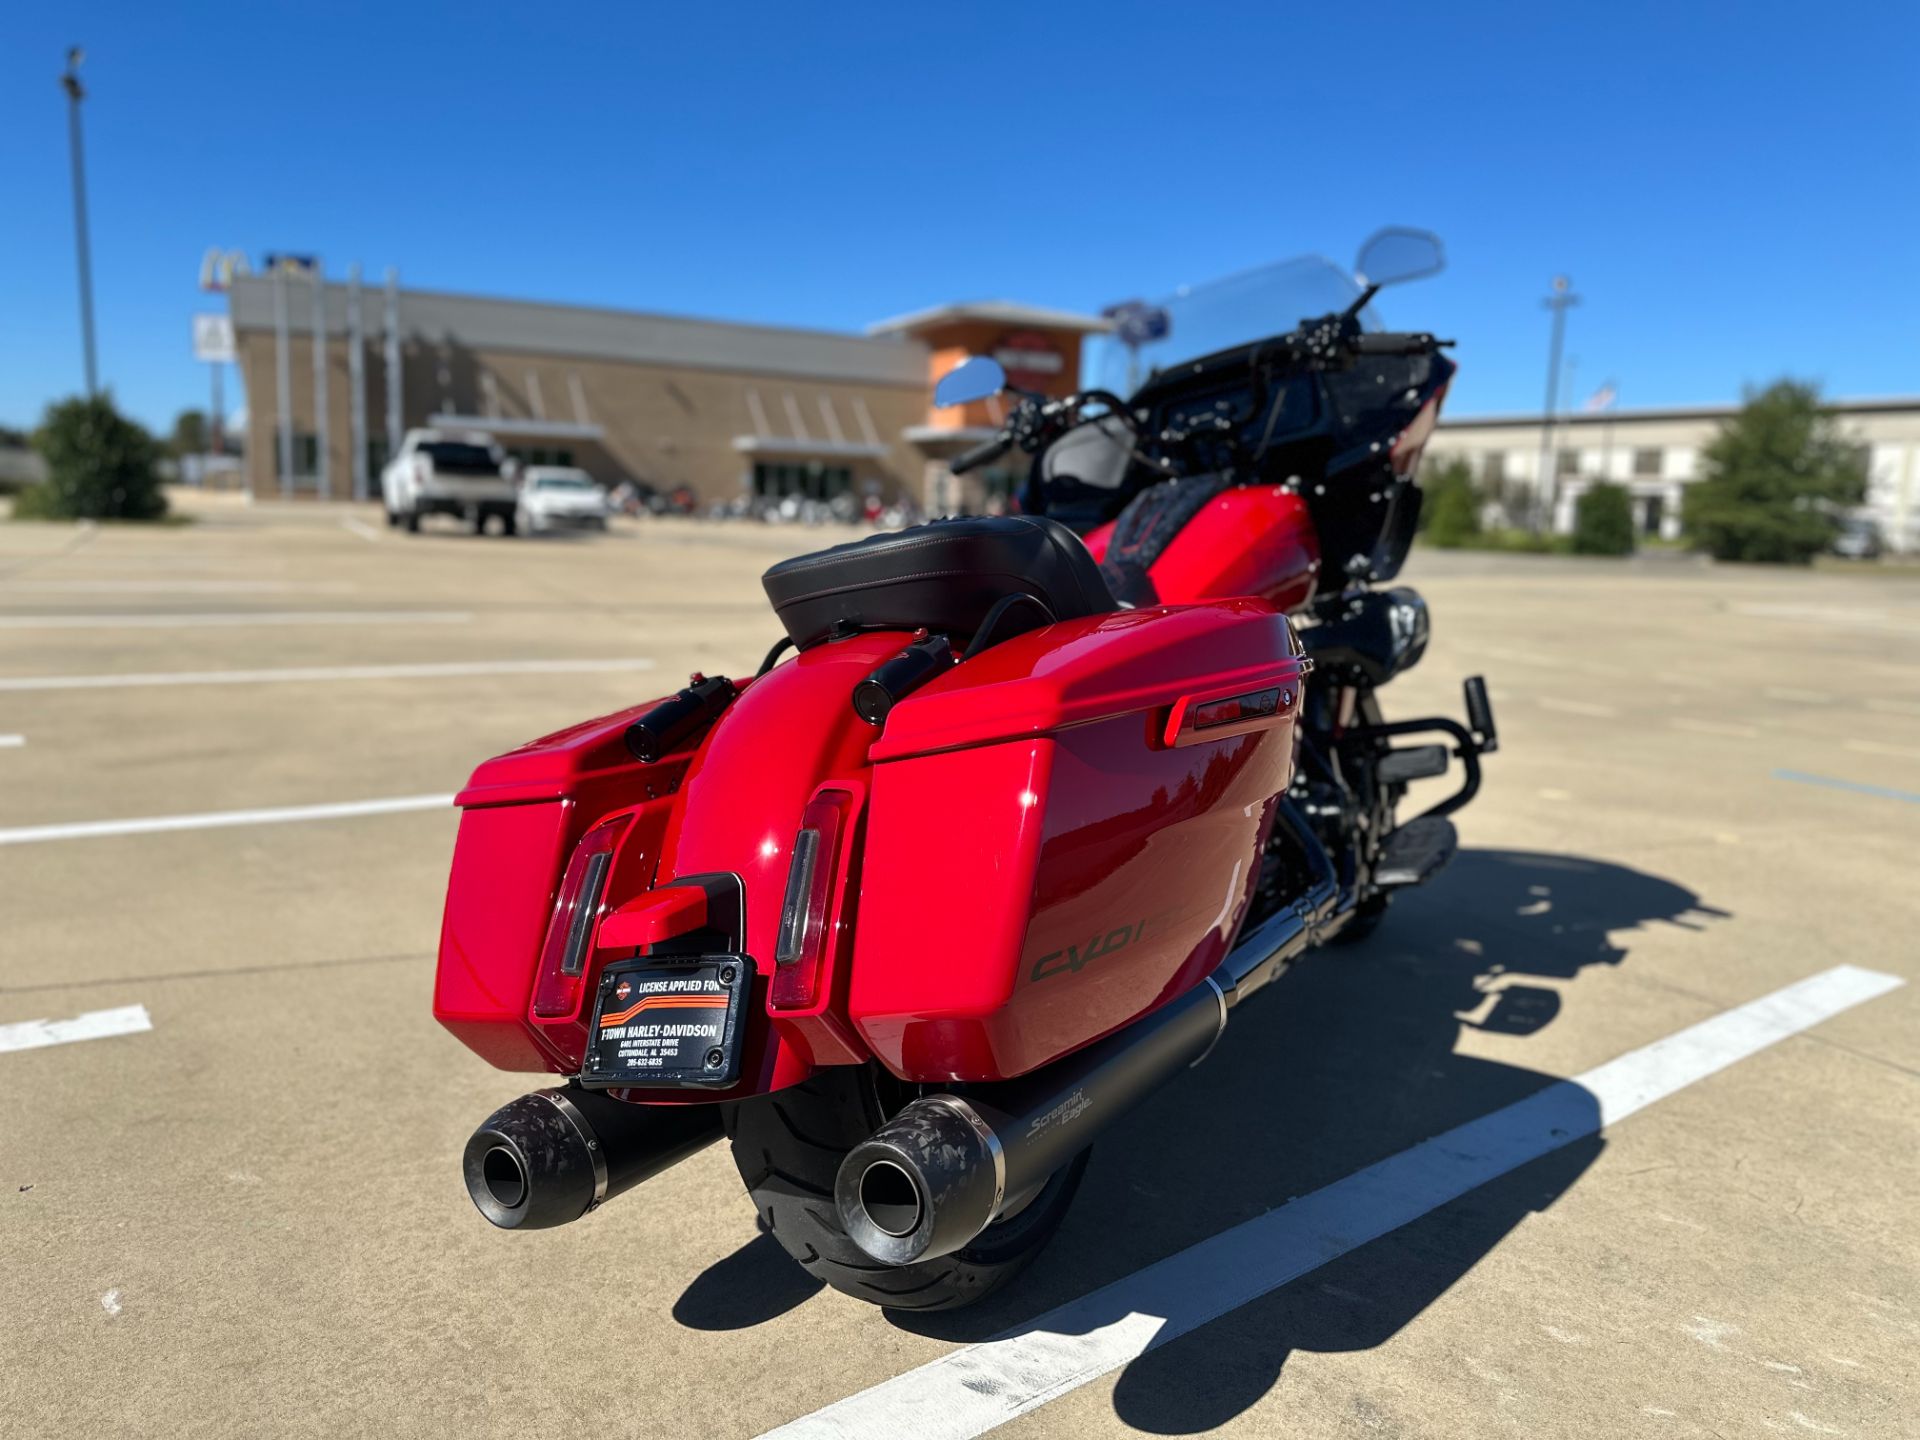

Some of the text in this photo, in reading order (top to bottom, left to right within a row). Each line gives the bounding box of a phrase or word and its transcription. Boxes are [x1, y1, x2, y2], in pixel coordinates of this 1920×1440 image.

[639, 981, 668, 993] LICENSE
[668, 981, 700, 992] APPLIED
[601, 1024, 717, 1041] T-TOWN HARLEY-DAVIDSON
[632, 1039, 661, 1048] INTERSTATE
[662, 1039, 679, 1047] DRIVE
[659, 1048, 678, 1057] 35453
[1062, 1098, 1093, 1125] Eagle
